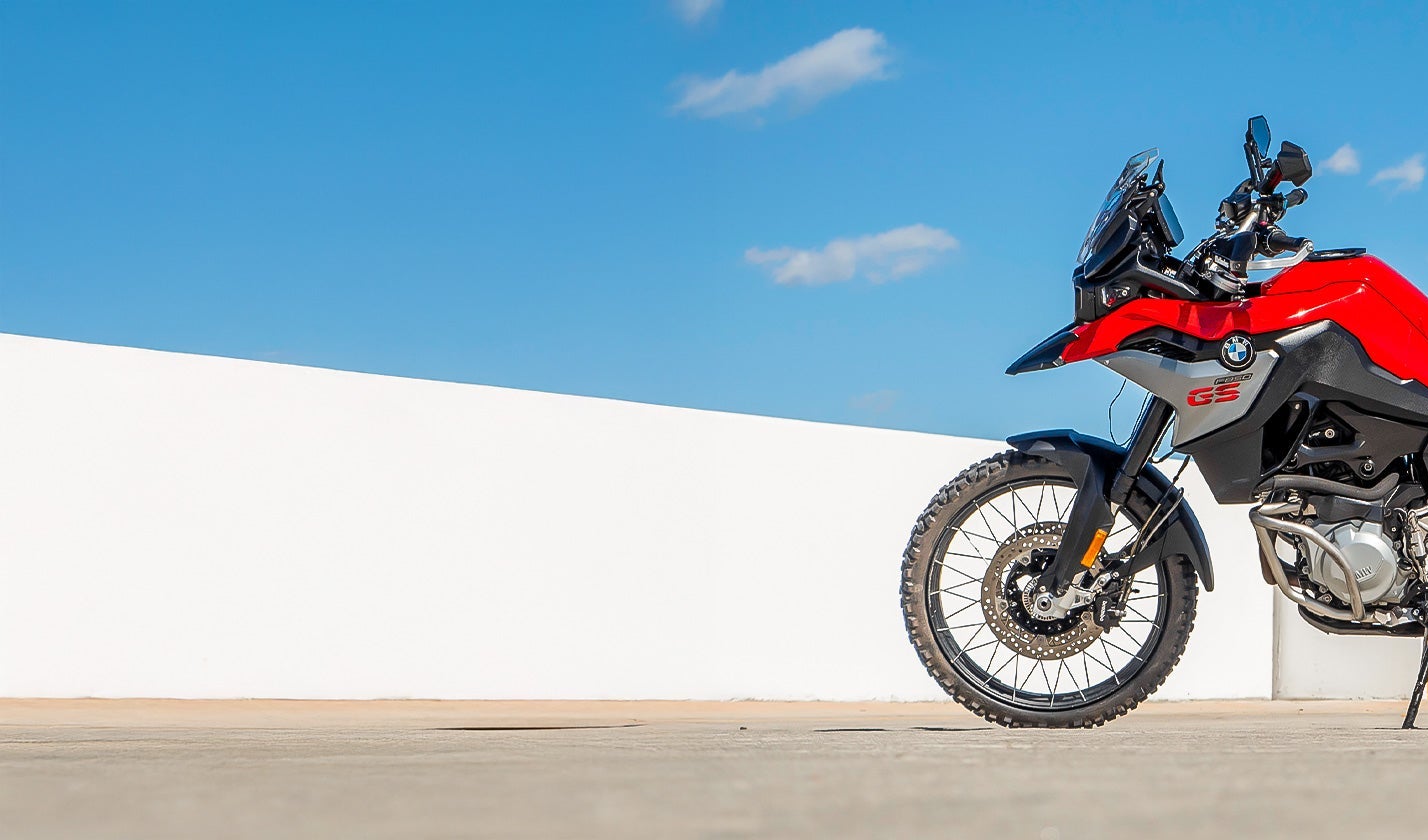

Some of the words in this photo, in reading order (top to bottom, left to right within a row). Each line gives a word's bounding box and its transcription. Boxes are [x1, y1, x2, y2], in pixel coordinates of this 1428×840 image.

[1224, 336, 1249, 349] BMW
[1187, 382, 1240, 406] GS
[1355, 566, 1372, 580] MW
